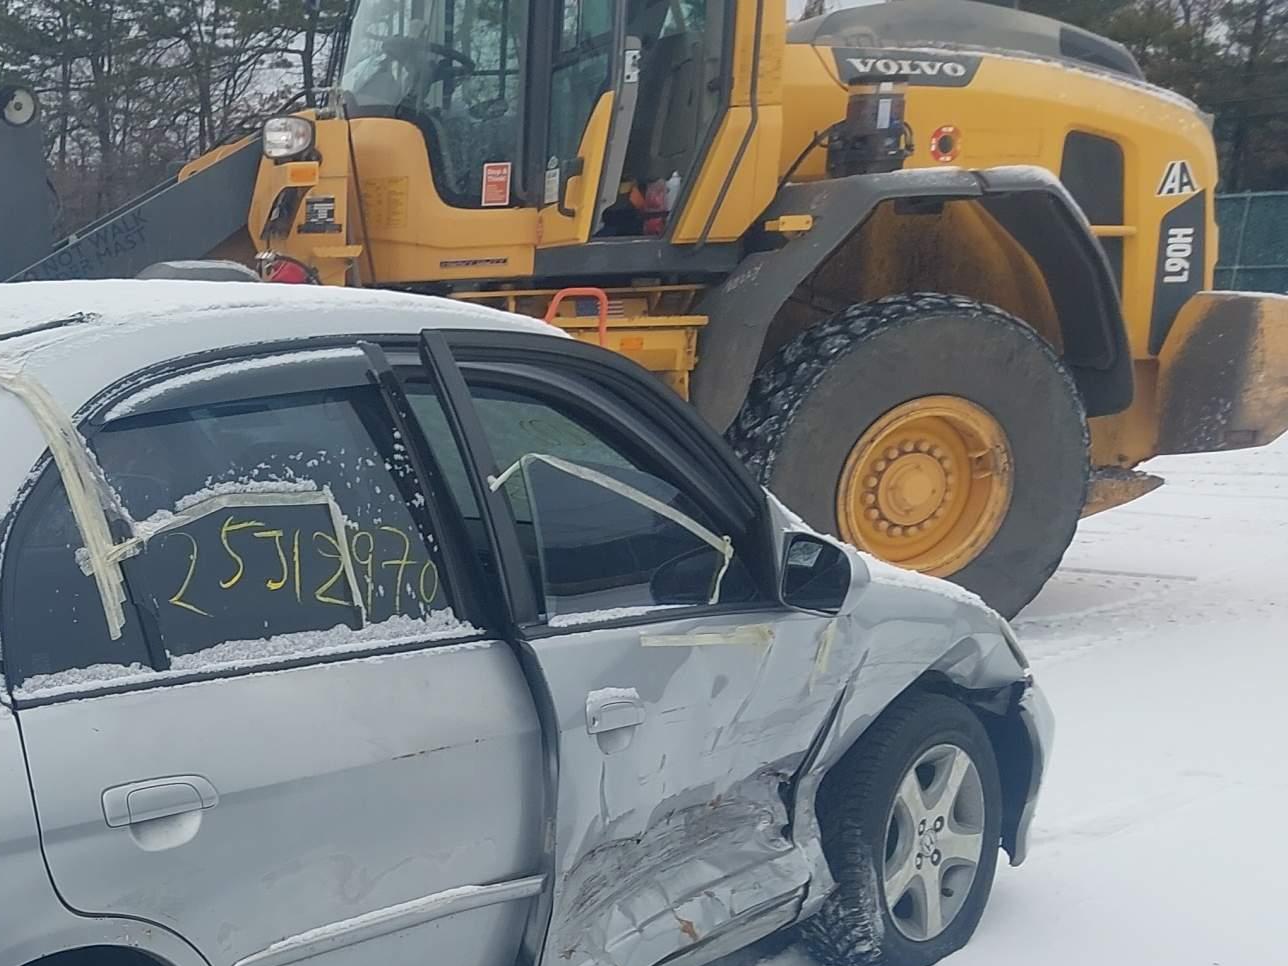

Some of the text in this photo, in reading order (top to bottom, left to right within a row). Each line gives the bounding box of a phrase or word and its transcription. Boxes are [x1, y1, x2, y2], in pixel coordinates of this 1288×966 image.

[845, 57, 967, 77] VOLVO
[42, 243, 86, 272] NOT
[87, 207, 149, 249] WALK
[96, 226, 147, 264] MAST
[1162, 226, 1195, 283] L90H
